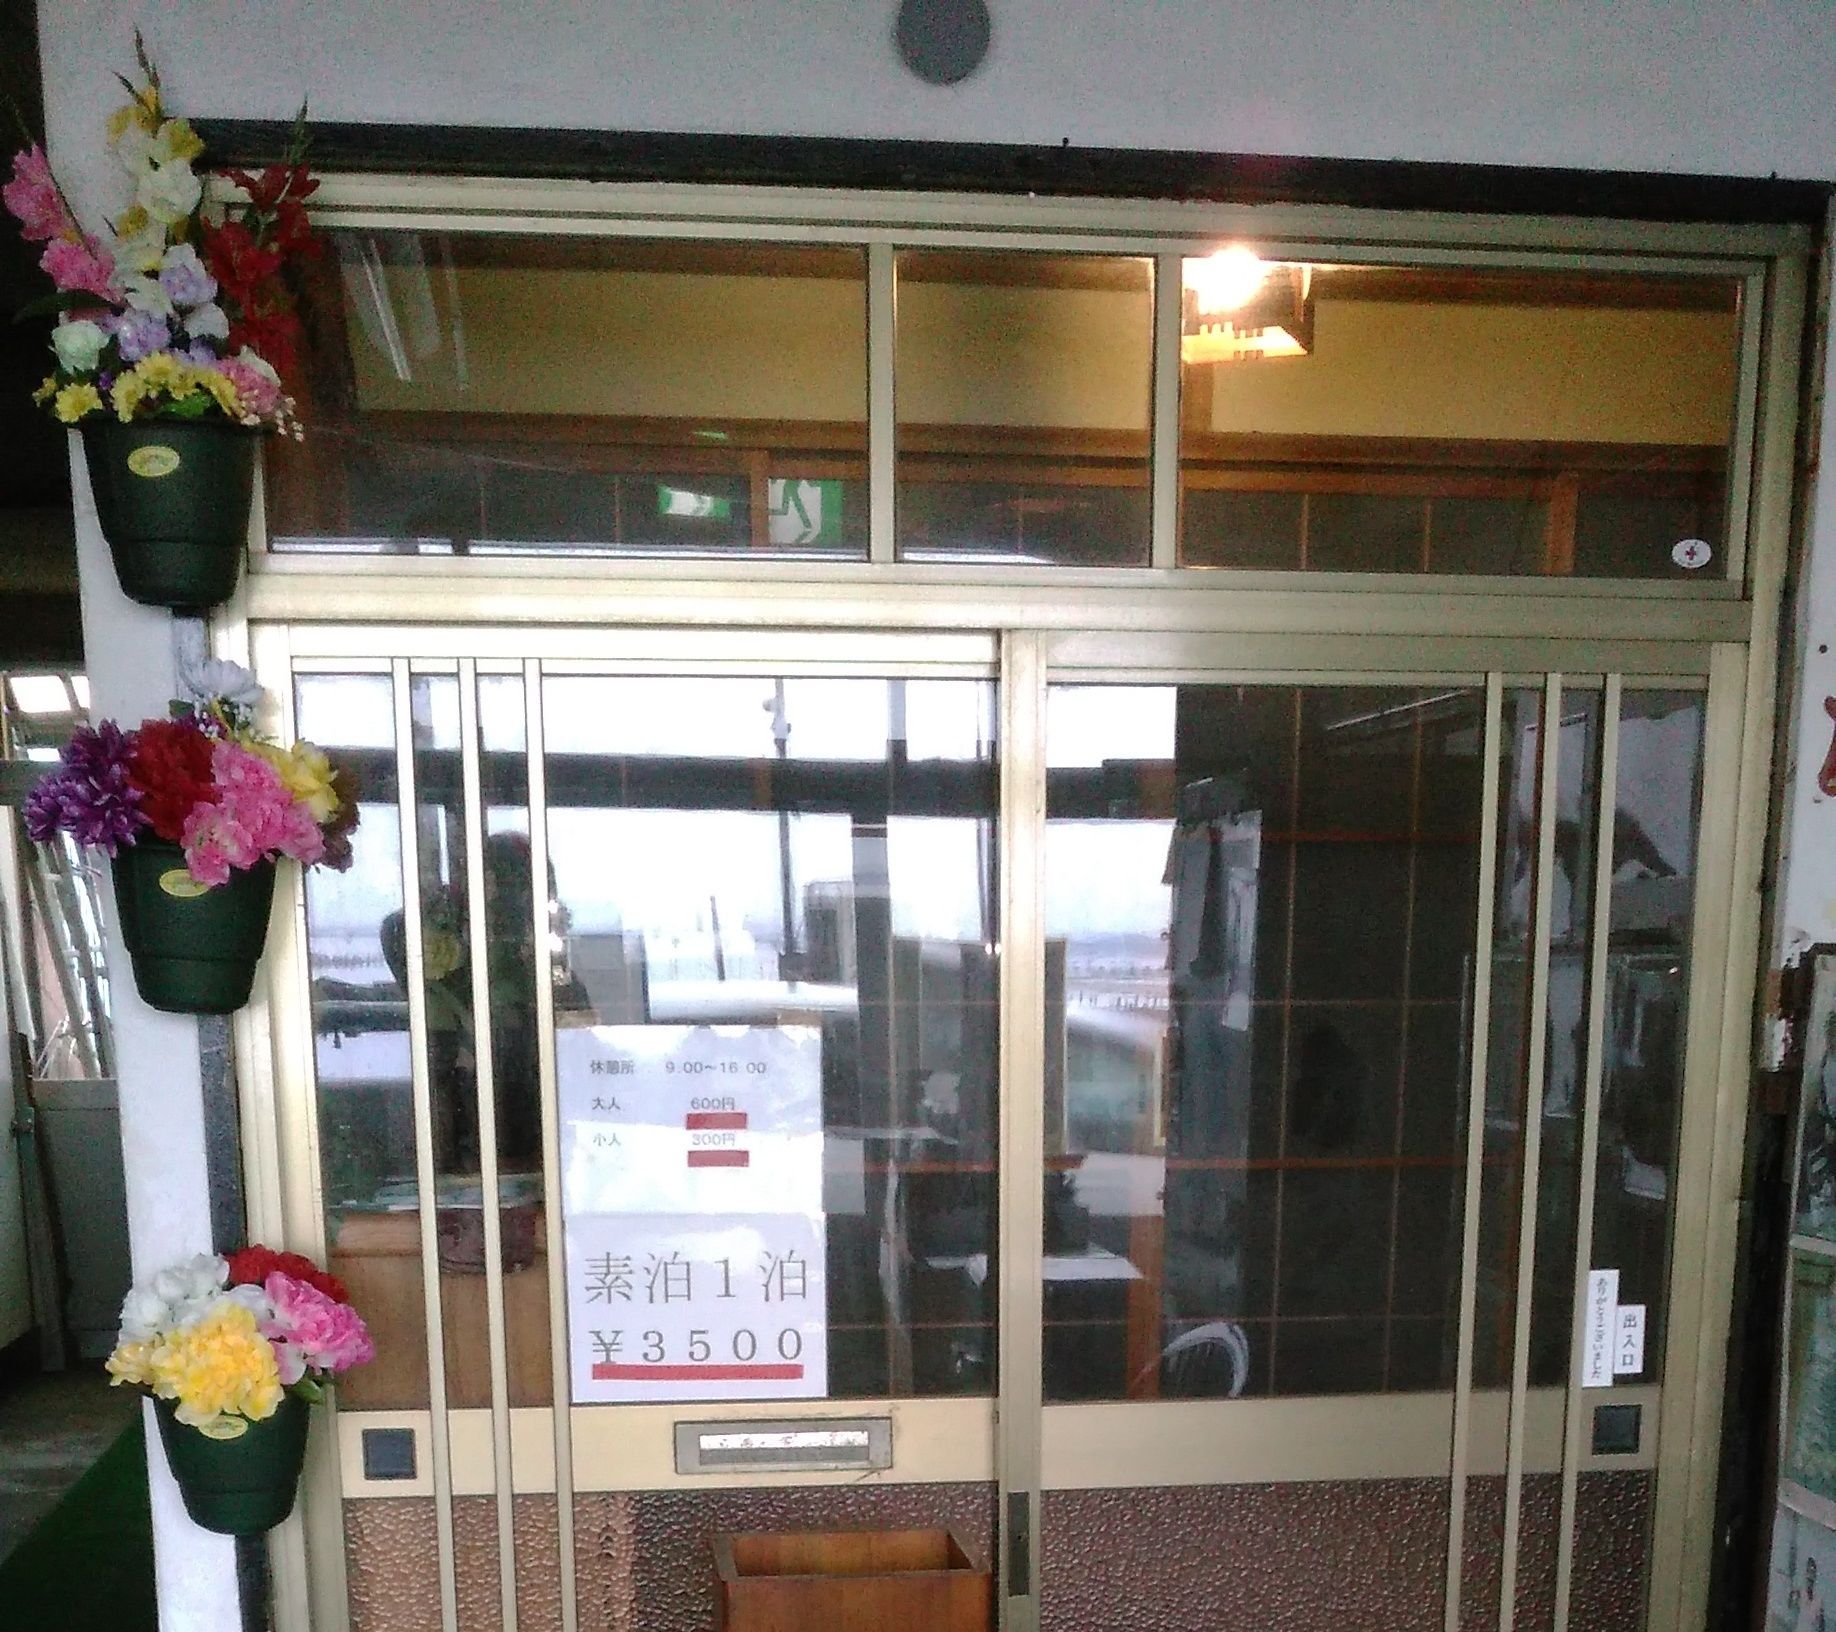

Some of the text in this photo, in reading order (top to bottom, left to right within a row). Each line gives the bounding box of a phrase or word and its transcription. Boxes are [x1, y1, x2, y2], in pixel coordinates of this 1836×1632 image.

[590, 1060, 634, 1075] 休憩所
[591, 1097, 736, 1111] 大人 600円
[592, 1133, 736, 1146] 小人 300円
[589, 1328, 803, 1363] ¥3500
[1622, 1314, 1638, 1366] 出入口
